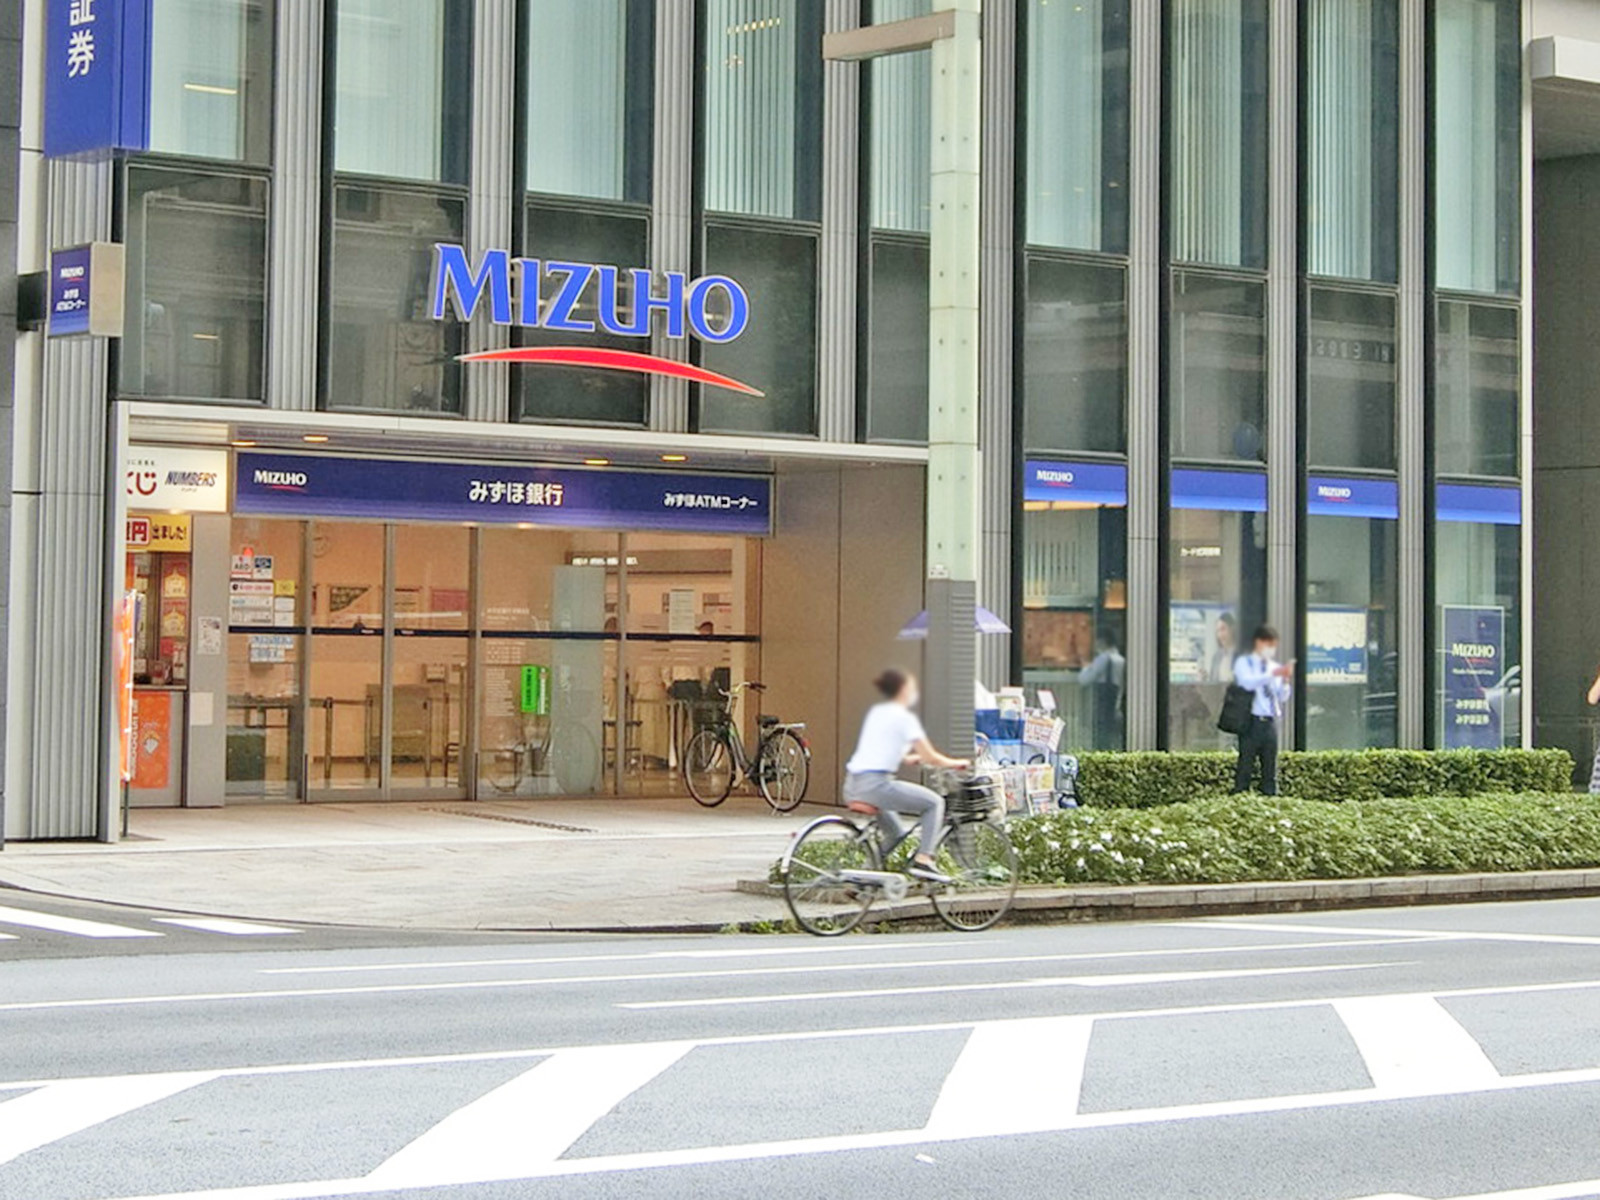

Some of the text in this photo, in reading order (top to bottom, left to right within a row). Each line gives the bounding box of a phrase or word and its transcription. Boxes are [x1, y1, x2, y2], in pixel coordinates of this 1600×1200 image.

[67, 0, 95, 77] 証券
[433, 243, 749, 343] MIZUHO
[164, 471, 217, 487] NUMBERS
[254, 469, 307, 486] MIZUHO
[1036, 469, 1073, 483] MIZUHO
[468, 480, 563, 506] みずほ銀行
[663, 492, 758, 509] みずほATMコーナー
[1317, 485, 1351, 499] MIZUHO
[126, 521, 148, 541] 円
[1452, 643, 1496, 658] MIZUHO
